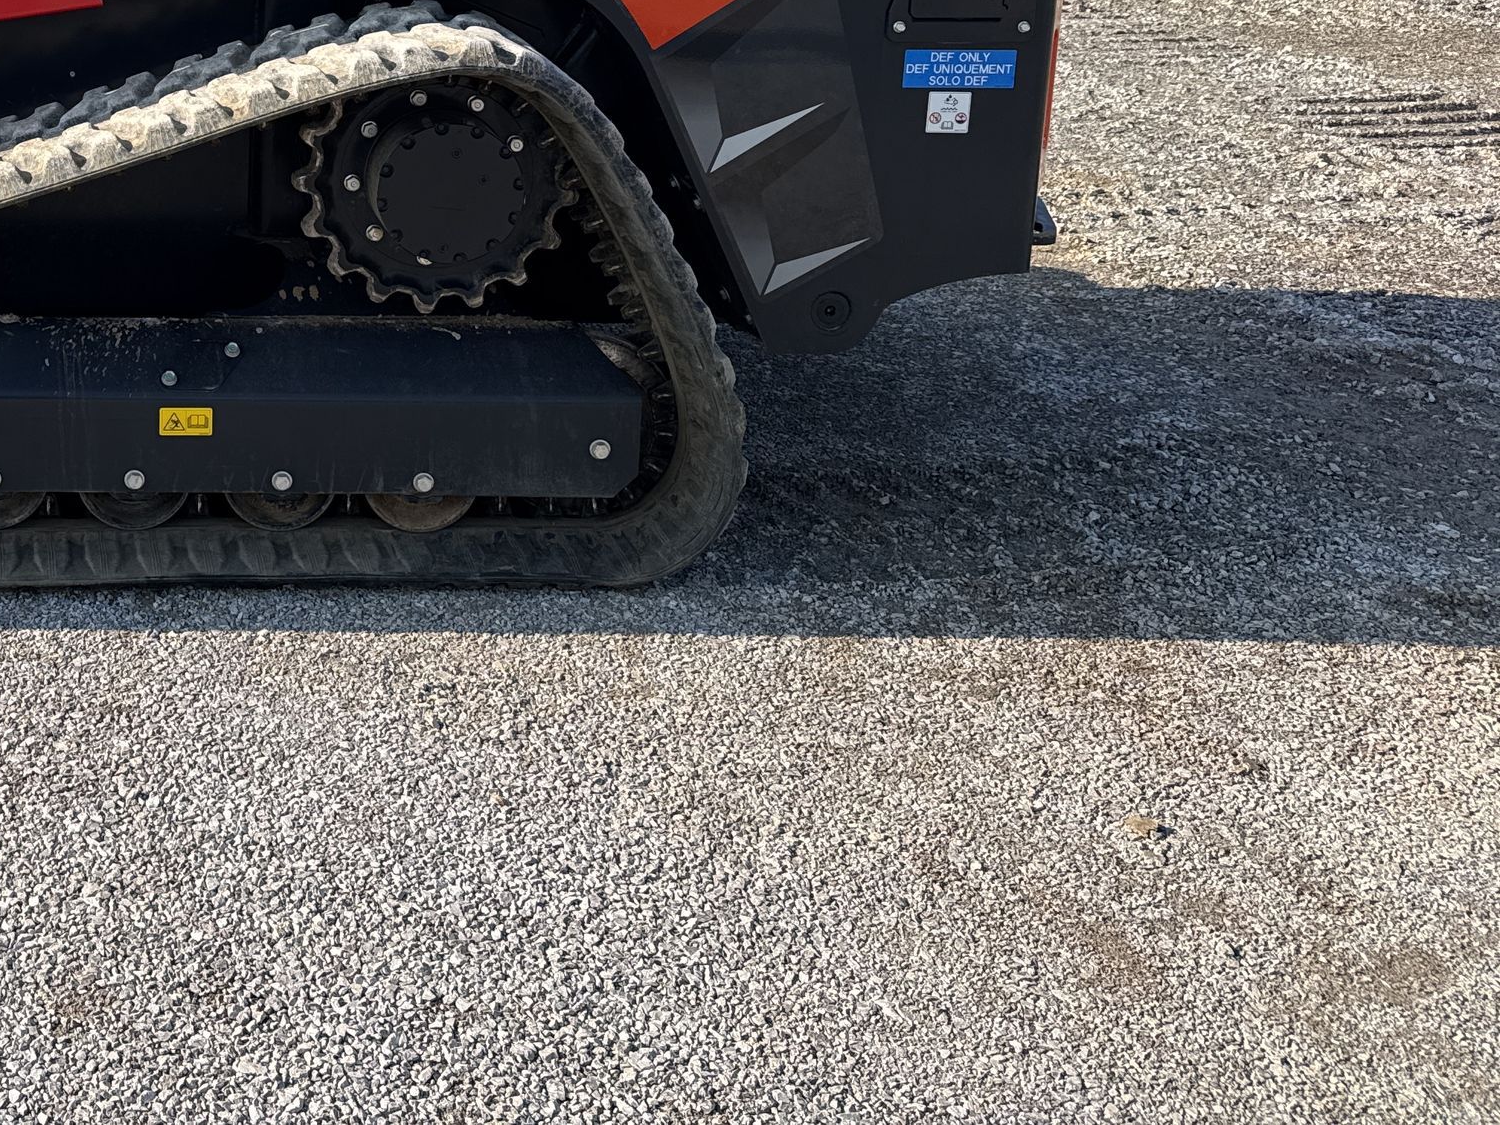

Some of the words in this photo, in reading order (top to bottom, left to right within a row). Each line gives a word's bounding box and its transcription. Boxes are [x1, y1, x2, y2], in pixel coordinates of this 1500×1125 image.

[930, 52, 954, 62] DEF
[959, 52, 991, 62] ONLY
[906, 63, 929, 74] DEF
[933, 63, 1013, 74] UNIQUEMENT
[928, 75, 960, 86] SOLO
[964, 75, 988, 86] DEF
